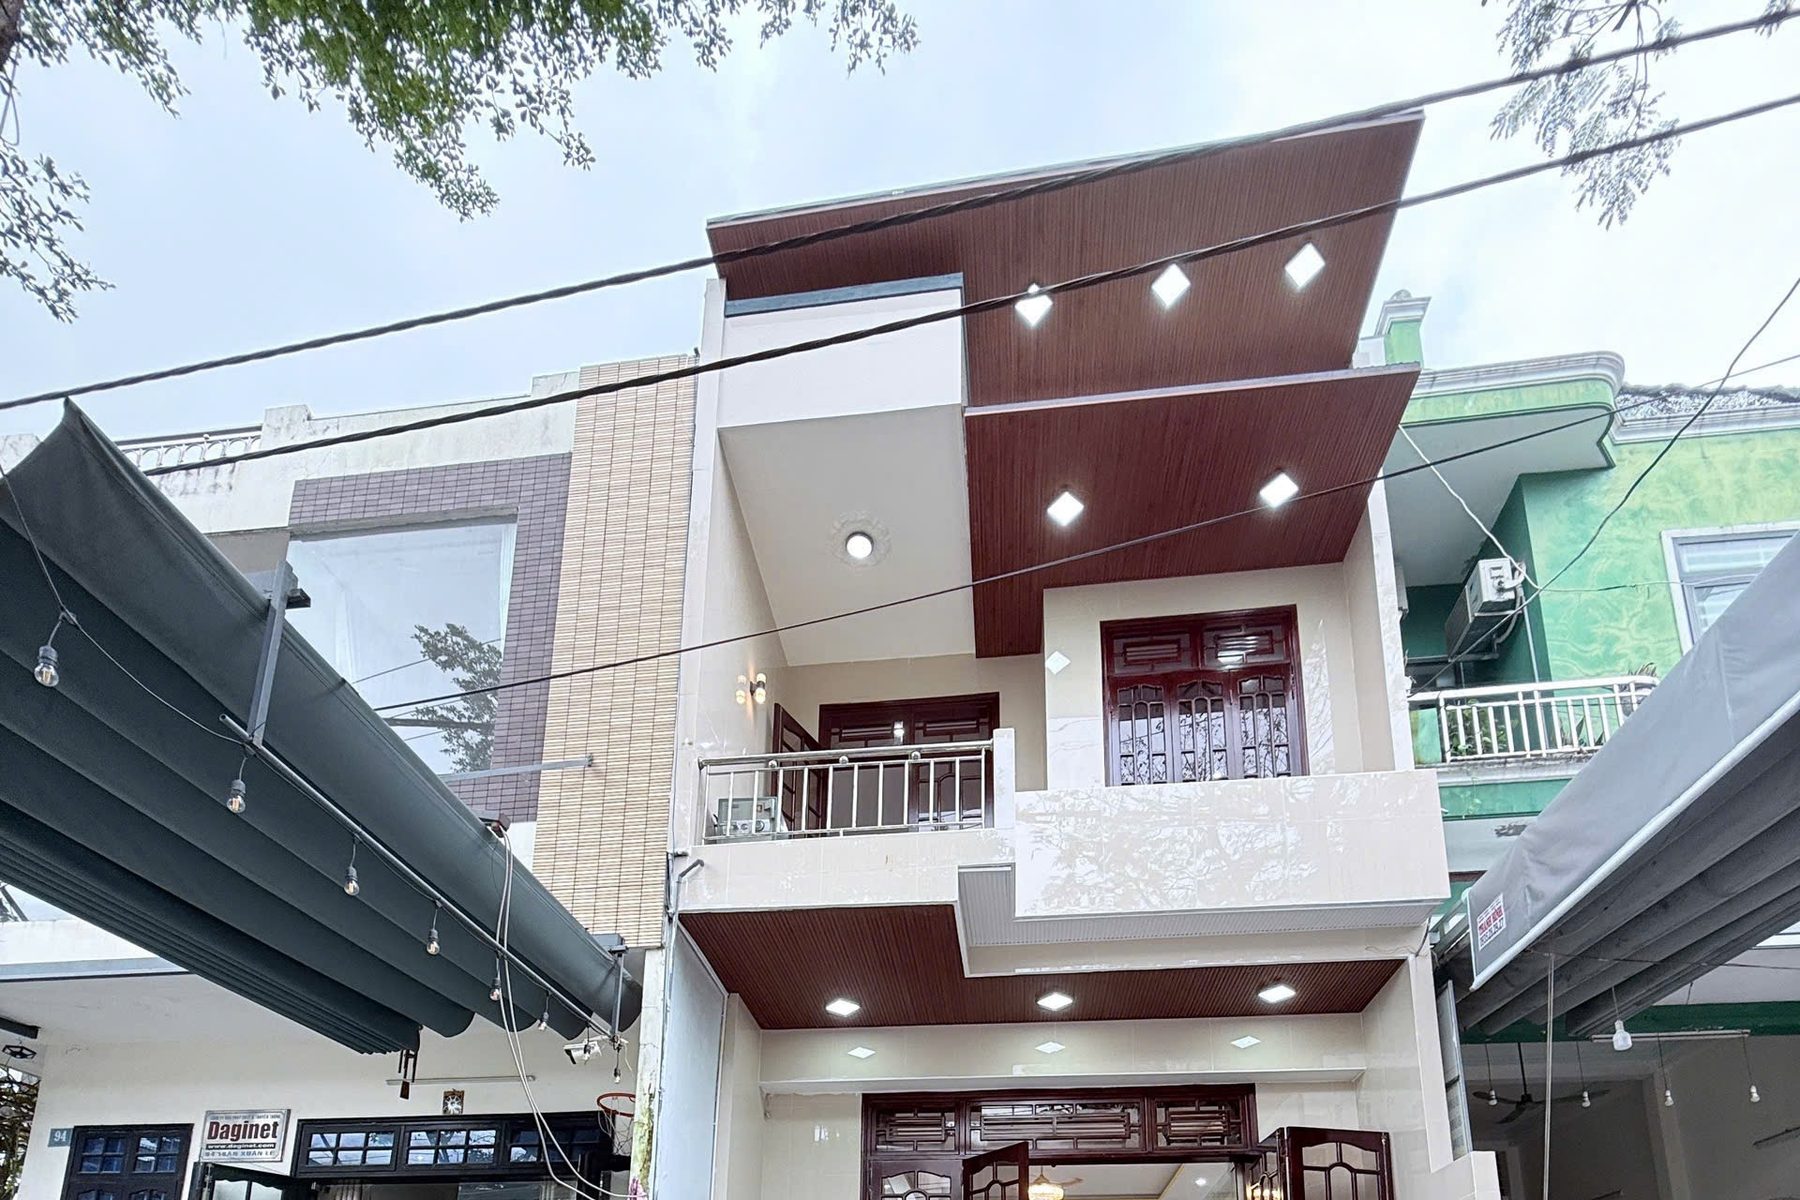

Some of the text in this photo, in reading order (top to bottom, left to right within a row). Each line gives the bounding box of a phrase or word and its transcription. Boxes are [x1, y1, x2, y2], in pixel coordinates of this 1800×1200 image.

[54, 1130, 67, 1142] 94
[207, 1120, 279, 1142] Daginet
[207, 1142, 275, 1150] www.daginet.com
